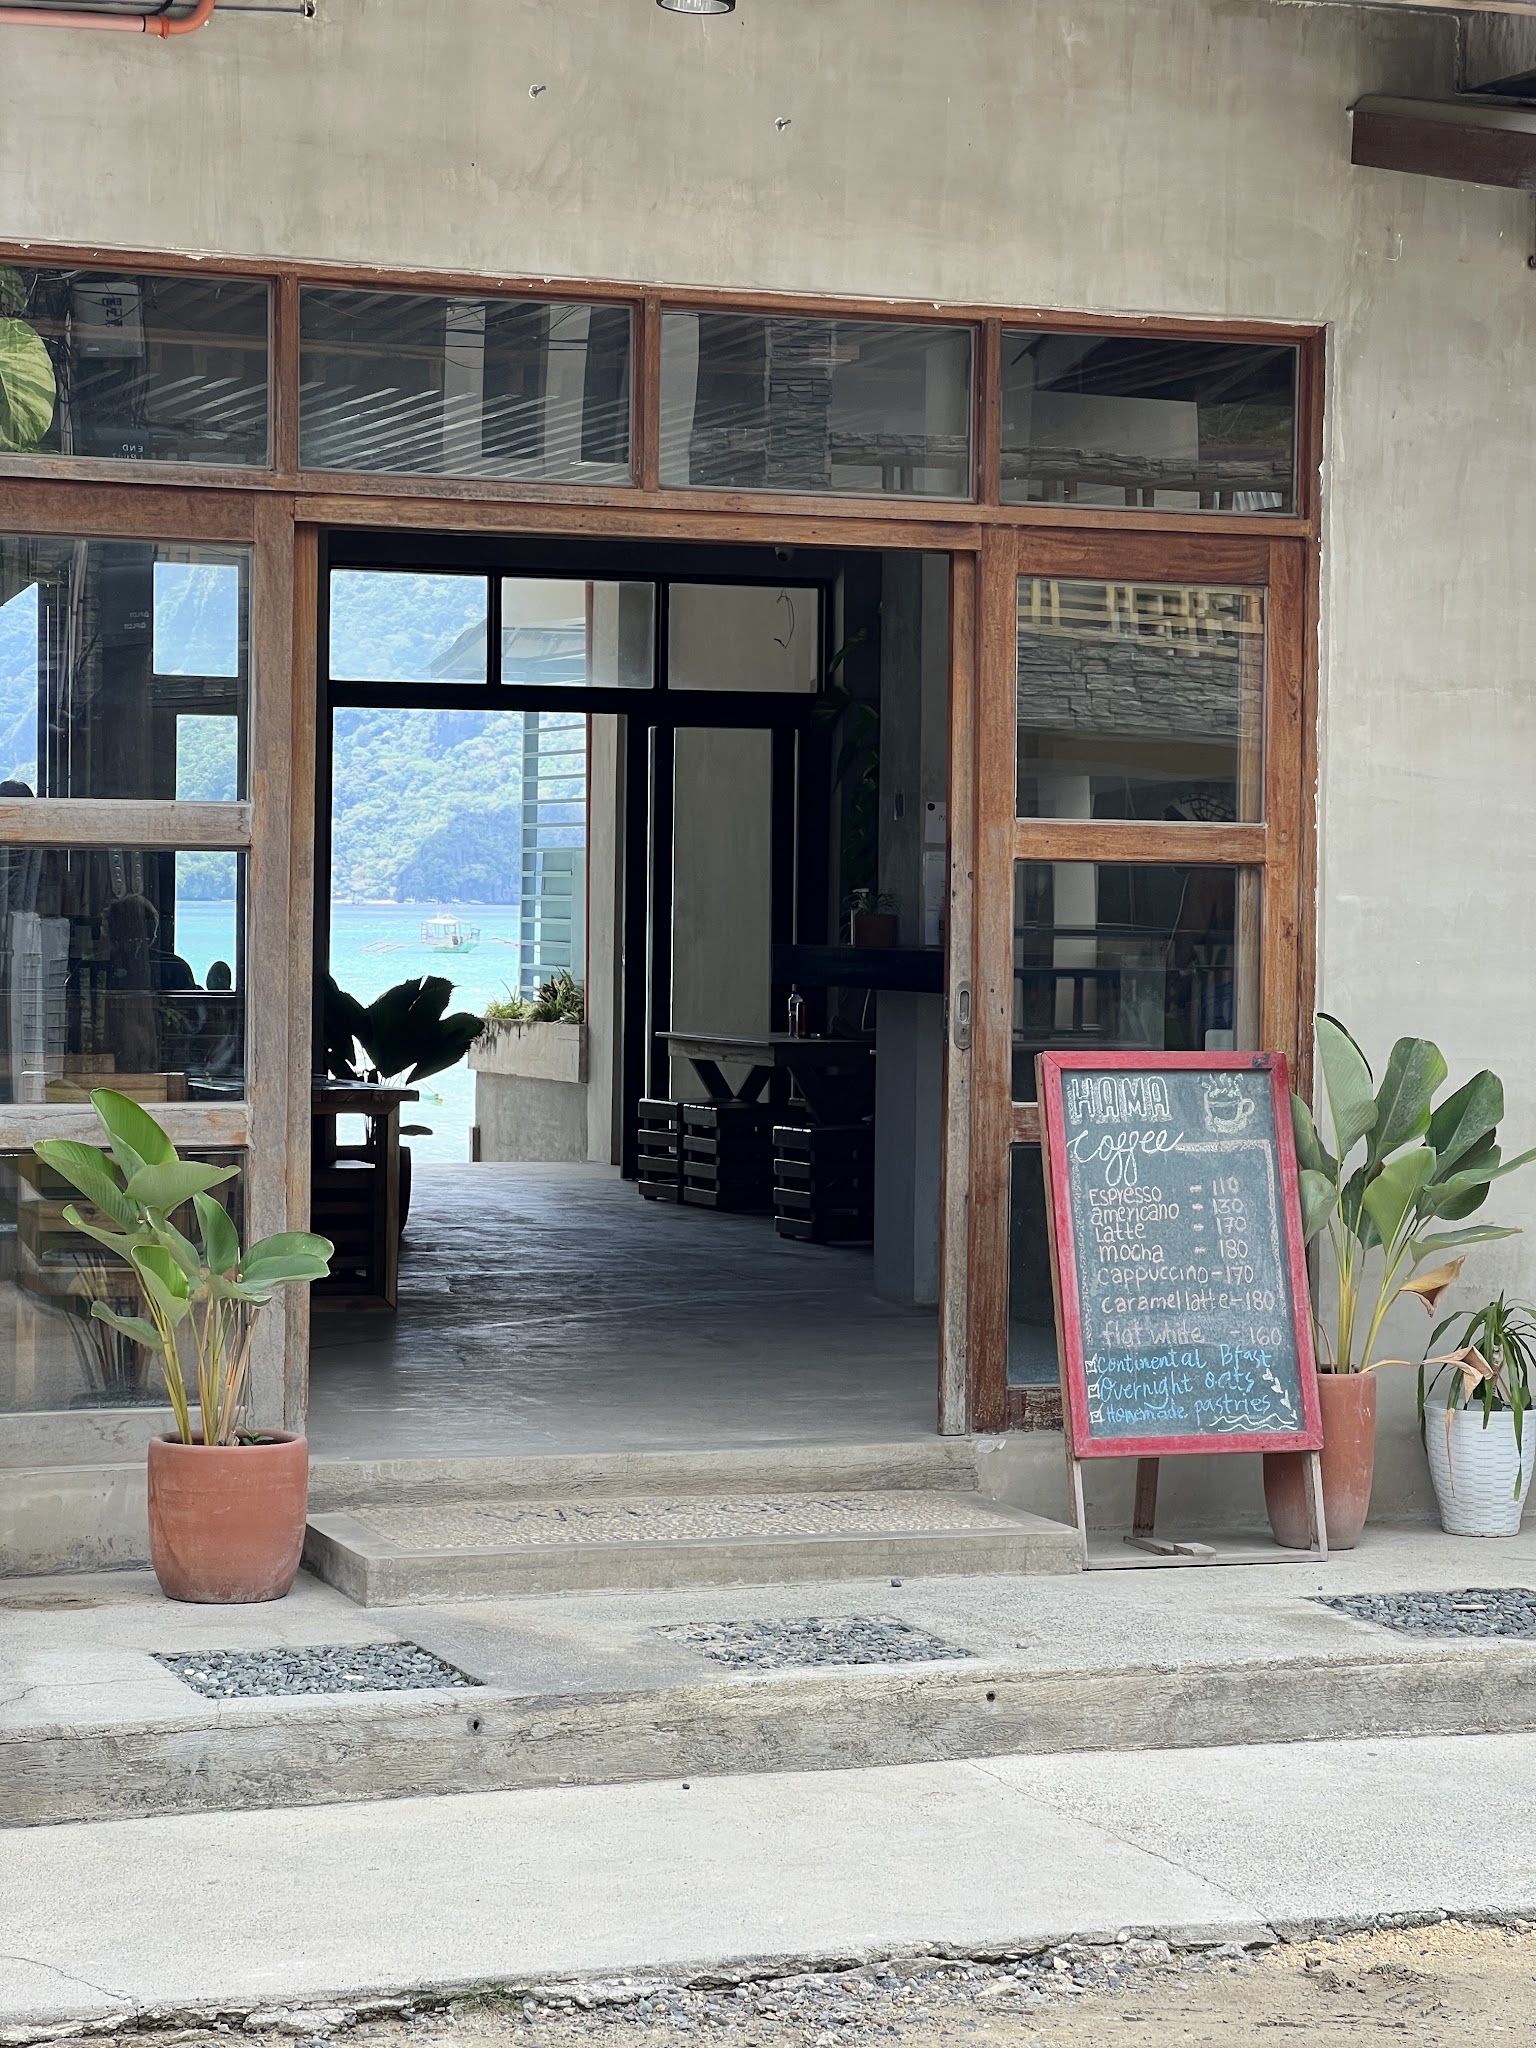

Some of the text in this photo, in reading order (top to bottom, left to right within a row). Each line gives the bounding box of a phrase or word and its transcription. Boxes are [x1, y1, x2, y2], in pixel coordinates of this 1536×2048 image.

[1068, 1075, 1172, 1124] HAMA
[1089, 1186, 1162, 1206] Espresso
[1212, 1176, 1240, 1196] 110
[1090, 1203, 1180, 1226] americano
[1212, 1198, 1245, 1215] 130
[1216, 1216, 1248, 1235] 170
[1099, 1243, 1164, 1264] mocha
[1220, 1238, 1248, 1259] 180
[1150, 1319, 1205, 1346] white
[1249, 1325, 1283, 1346] 160
[1219, 1343, 1272, 1370] Bfast
[1100, 1370, 1194, 1410] Overnight
[1193, 1392, 1271, 1426] pastries
[474, 1498, 888, 1523] WELCOME
